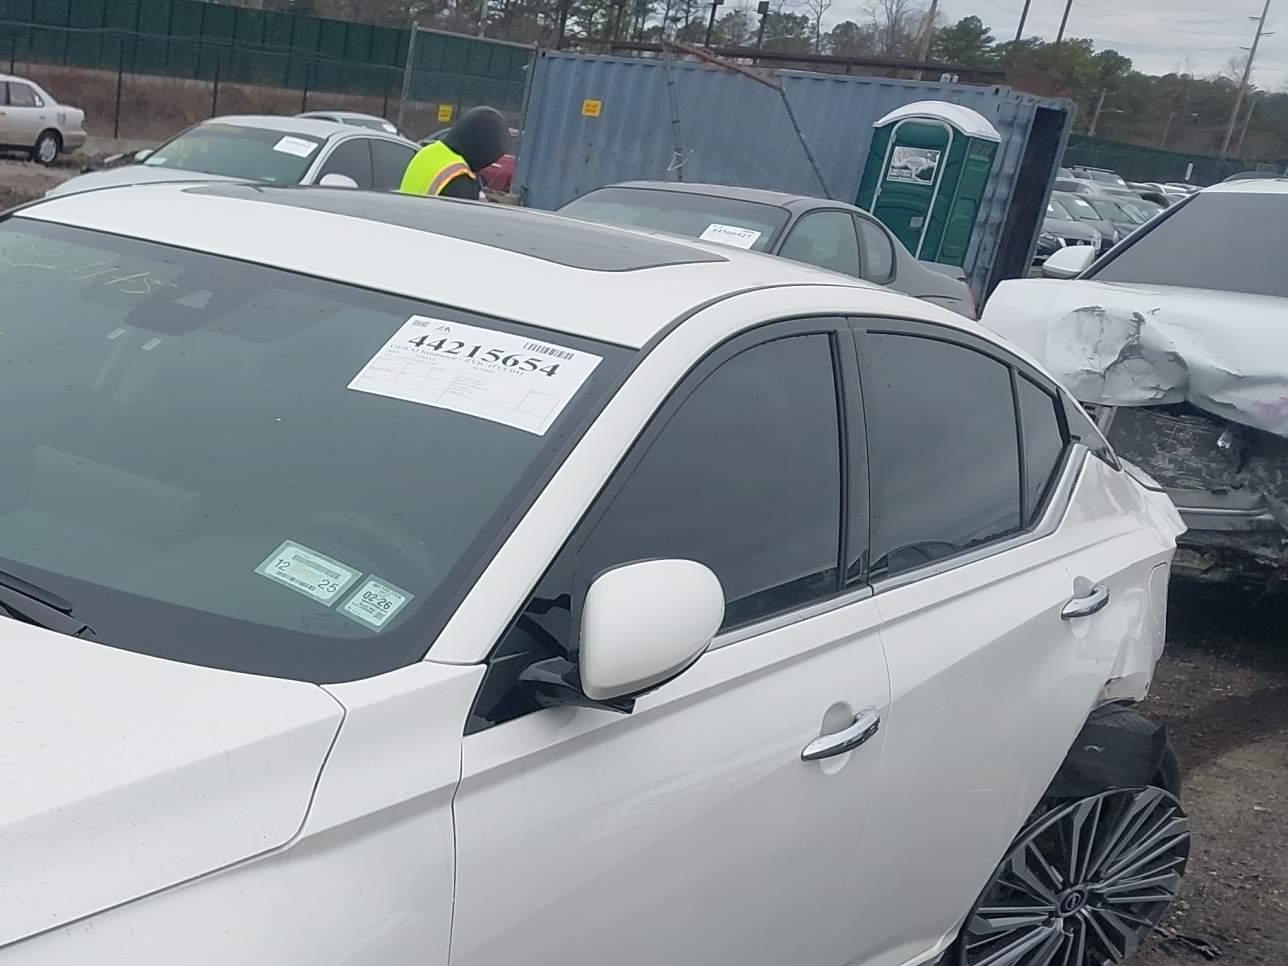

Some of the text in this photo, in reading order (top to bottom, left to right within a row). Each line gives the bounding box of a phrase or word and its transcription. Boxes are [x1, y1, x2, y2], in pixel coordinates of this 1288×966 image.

[408, 334, 560, 378] 44215654
[273, 558, 291, 572] 12
[317, 578, 340, 593] 25
